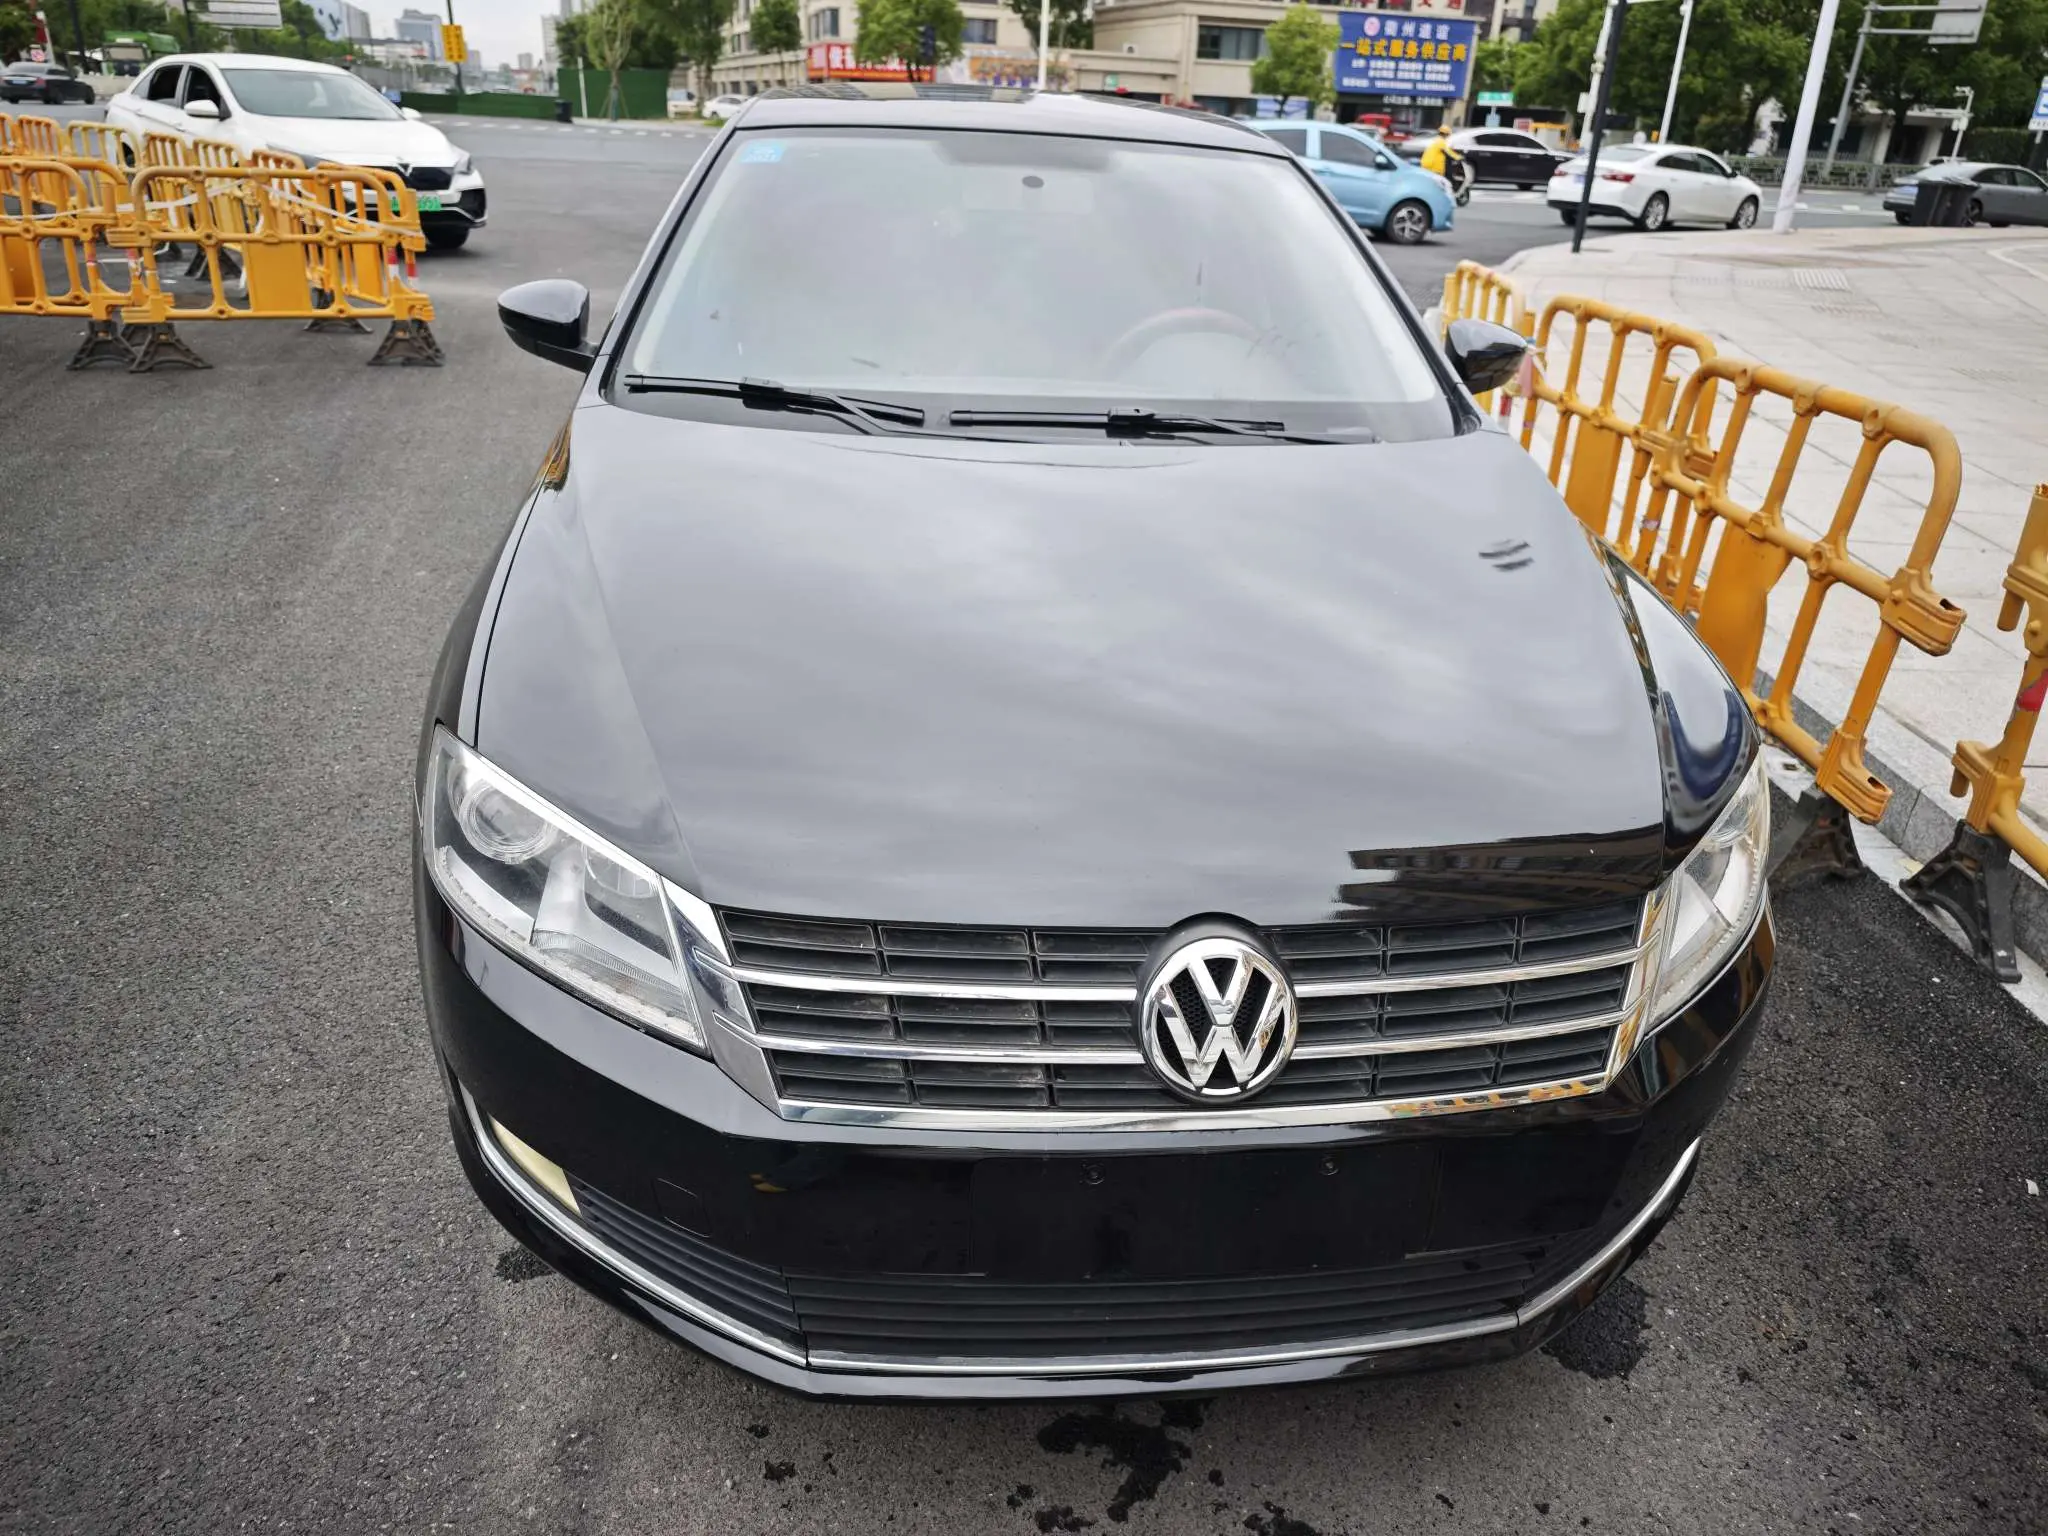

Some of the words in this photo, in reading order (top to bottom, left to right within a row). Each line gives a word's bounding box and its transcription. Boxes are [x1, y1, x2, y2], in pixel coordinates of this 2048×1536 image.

[1340, 37, 1468, 61] 一站式服务供应商
